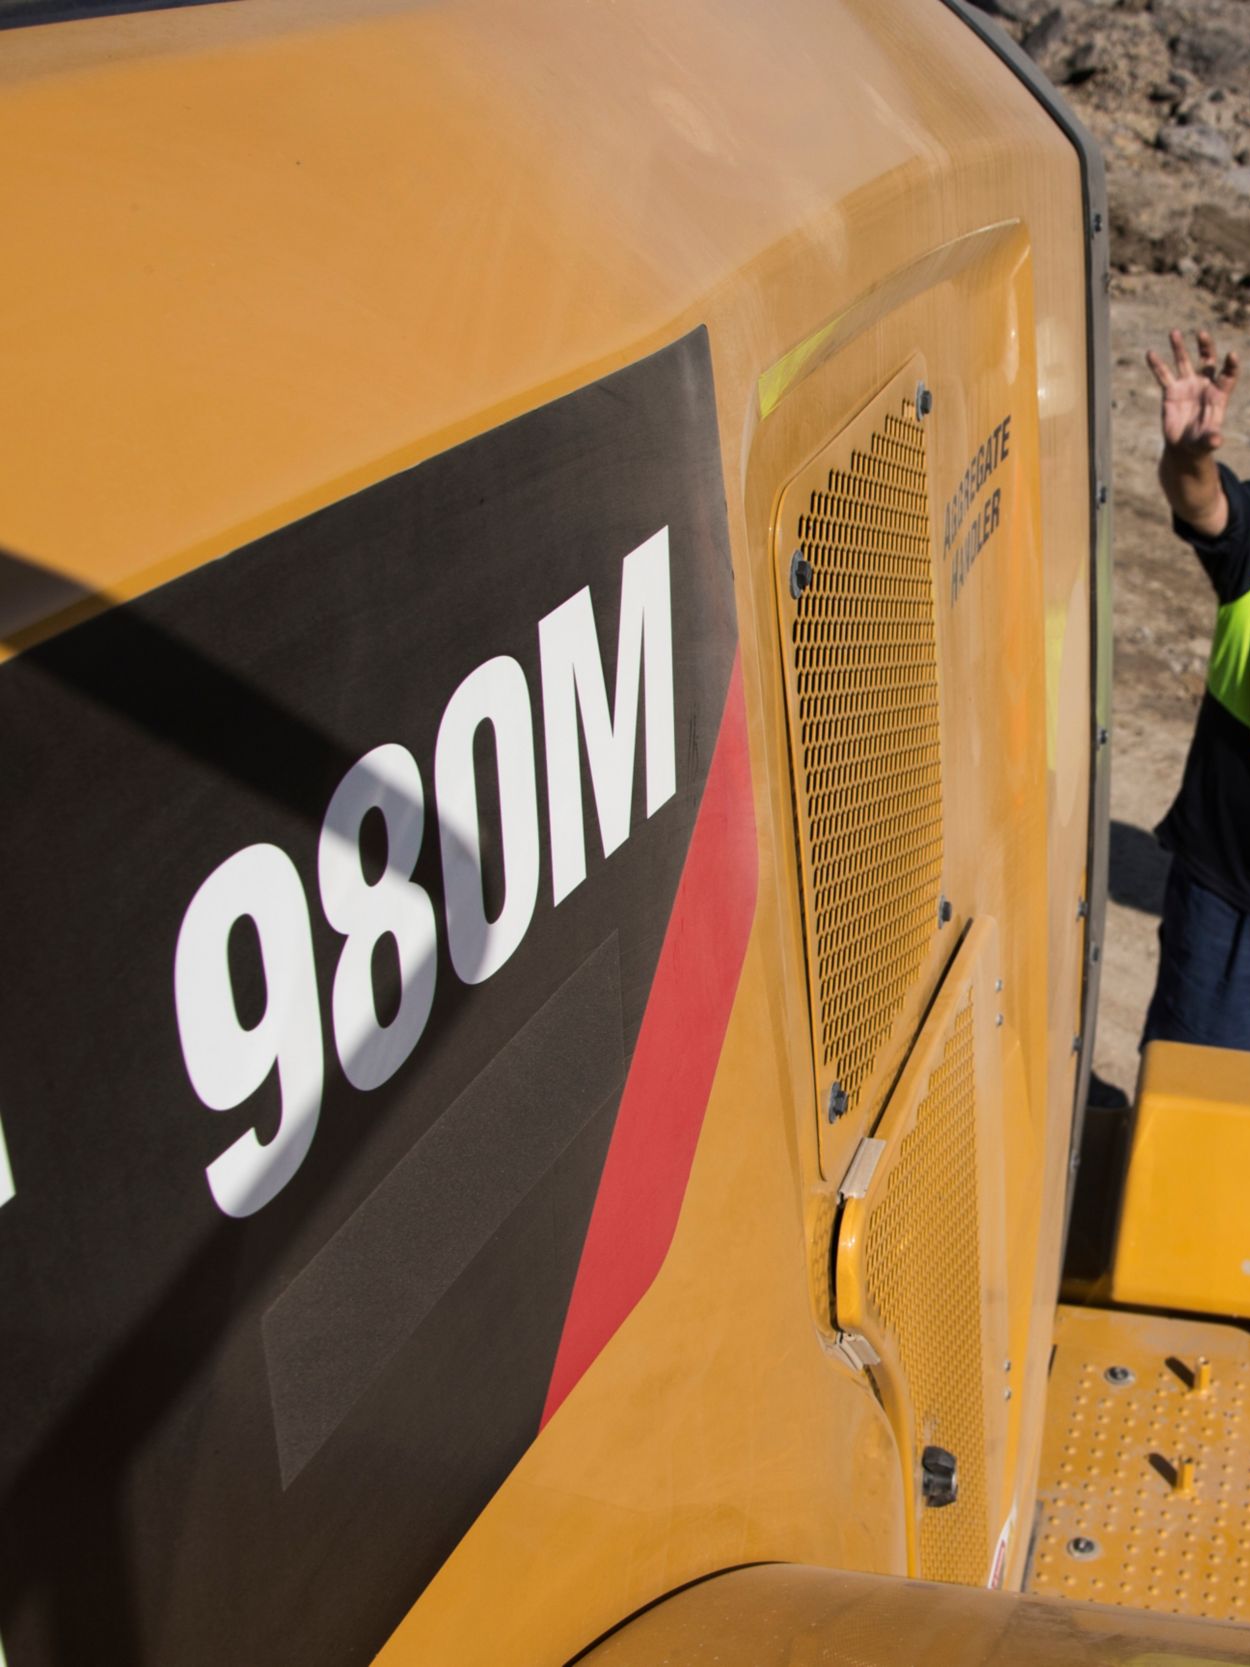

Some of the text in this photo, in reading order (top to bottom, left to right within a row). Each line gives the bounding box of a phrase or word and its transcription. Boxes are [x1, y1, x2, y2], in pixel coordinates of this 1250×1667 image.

[943, 414, 1012, 561] AGGREGATE
[951, 488, 1002, 608] HANDLER
[175, 525, 677, 1218] 980M
